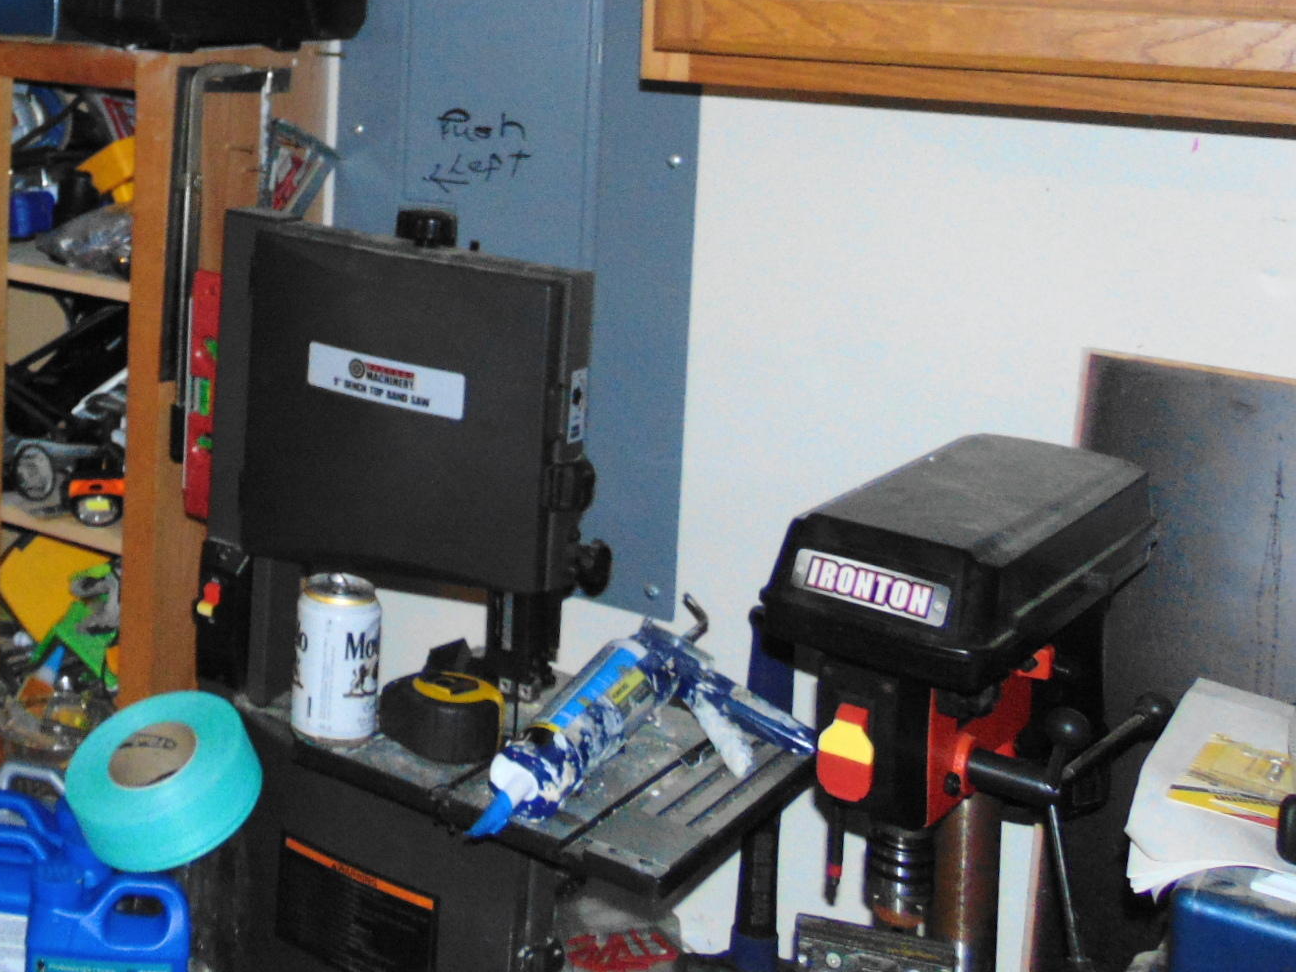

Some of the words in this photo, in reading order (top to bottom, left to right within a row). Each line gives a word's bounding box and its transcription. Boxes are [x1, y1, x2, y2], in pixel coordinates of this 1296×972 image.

[365, 372, 415, 390] MACHINERY
[369, 386, 385, 399] TOP
[410, 395, 431, 408] SAW
[805, 555, 934, 619] IRONTON
